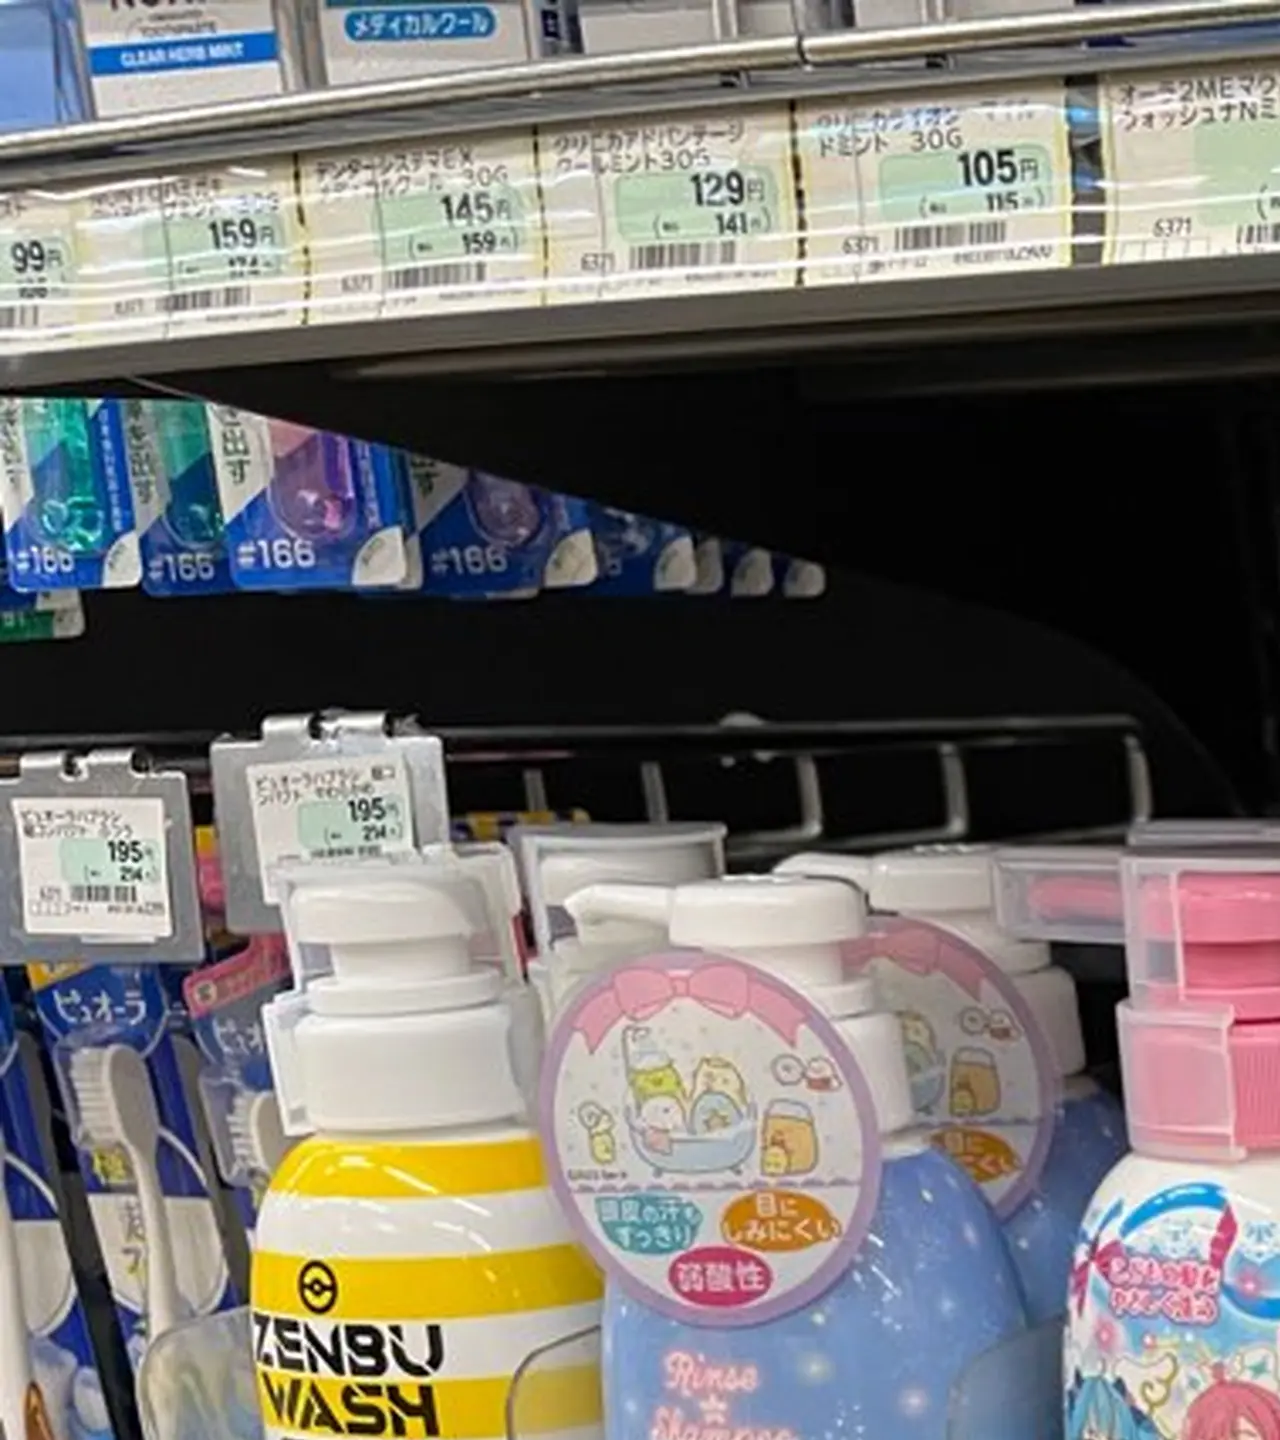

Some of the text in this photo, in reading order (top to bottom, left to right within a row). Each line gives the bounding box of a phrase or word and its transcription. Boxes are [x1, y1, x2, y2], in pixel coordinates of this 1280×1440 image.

[353, 12, 490, 37] メディカルクール
[14, 546, 75, 574] #166
[148, 553, 216, 582] #166
[236, 539, 317, 569] #166
[430, 544, 509, 578] #166
[53, 988, 148, 1025] ピュオーラ
[755, 1195, 797, 1218] 目に
[617, 1221, 692, 1247] すっきり
[723, 1214, 841, 1242] しみにくい
[676, 1263, 766, 1293] 弱酸性
[252, 1313, 444, 1378] ZENBU
[262, 1375, 439, 1436] WASH
